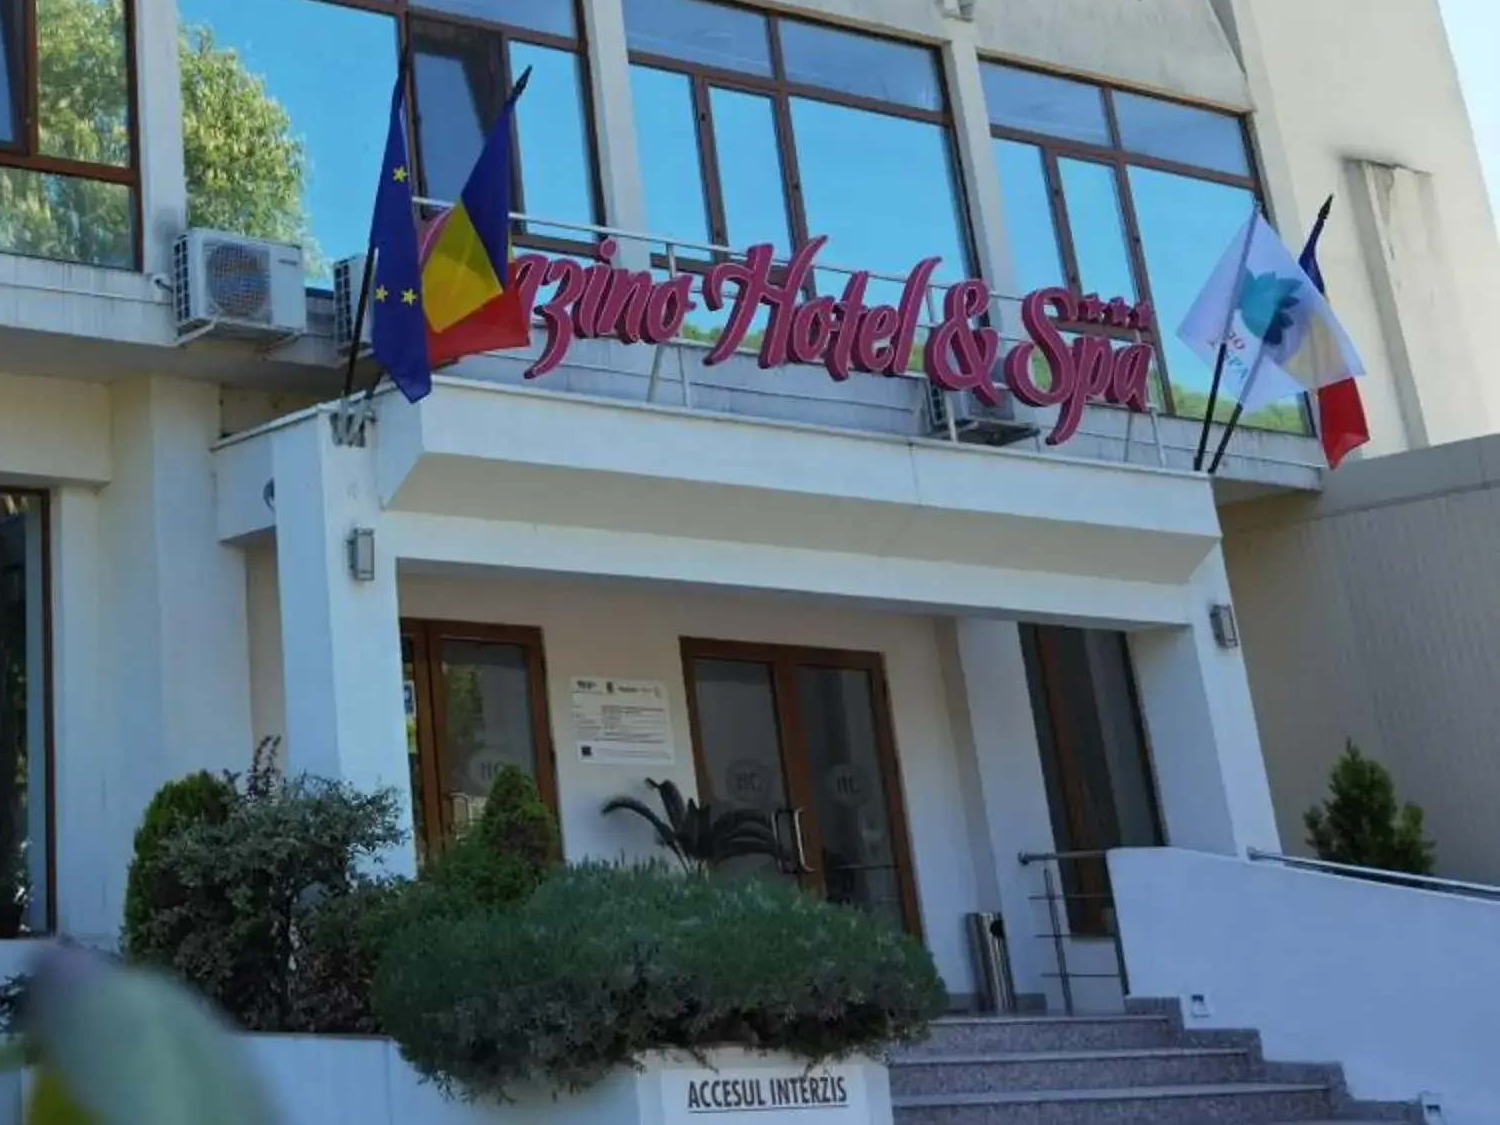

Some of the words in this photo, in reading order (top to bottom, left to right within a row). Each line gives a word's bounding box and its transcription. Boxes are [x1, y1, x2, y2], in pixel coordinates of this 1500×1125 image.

[702, 235, 942, 382] Hotel
[924, 278, 1001, 407] &
[1004, 286, 1155, 446] Spa
[688, 1078, 766, 1108] ACCESUL
[769, 1076, 847, 1105] INTERZIS
